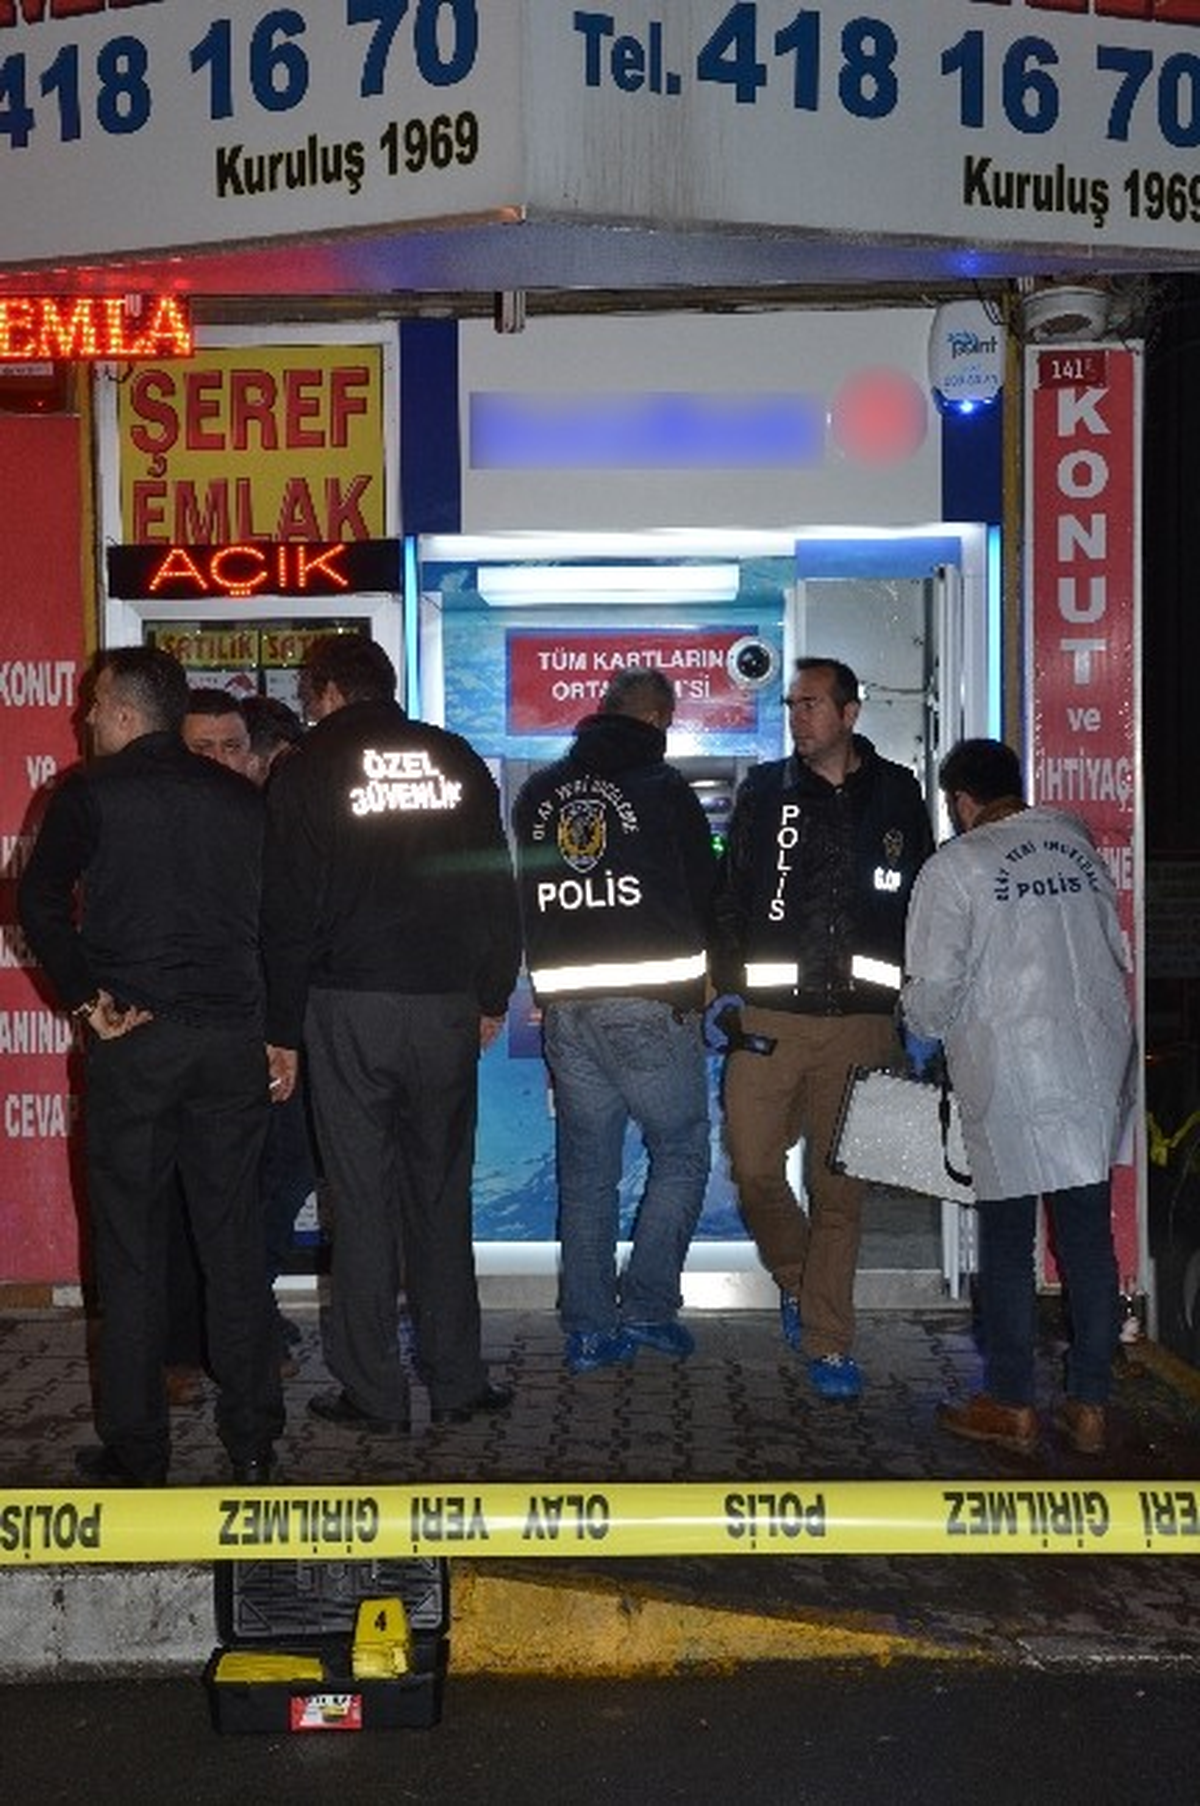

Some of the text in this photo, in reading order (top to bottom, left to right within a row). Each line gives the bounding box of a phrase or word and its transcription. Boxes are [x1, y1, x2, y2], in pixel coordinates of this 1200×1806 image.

[0, 0, 479, 149] 418 16 70
[573, 2, 1200, 148] Tel. 418 16 70
[216, 111, 479, 197] Kuruluş 1969
[963, 155, 1200, 228] Kuruluş 1969
[130, 367, 370, 478] ŞEREF
[132, 473, 374, 543] EMLAK
[1056, 386, 1111, 685] KONUT
[149, 544, 349, 595] AÇIK
[538, 646, 587, 671] TÜM
[1066, 705, 1102, 732] ve
[363, 748, 441, 779] ÖZEL
[537, 869, 642, 913] POLİS
[768, 804, 801, 921] POLİS
[1016, 871, 1082, 899] POLİS
[0, 1490, 1200, 1560] ERİ GİRİLMEZ POLİS OLAY YERİ GİRİLMEZ POLİS
[374, 1610, 387, 1632] 4
